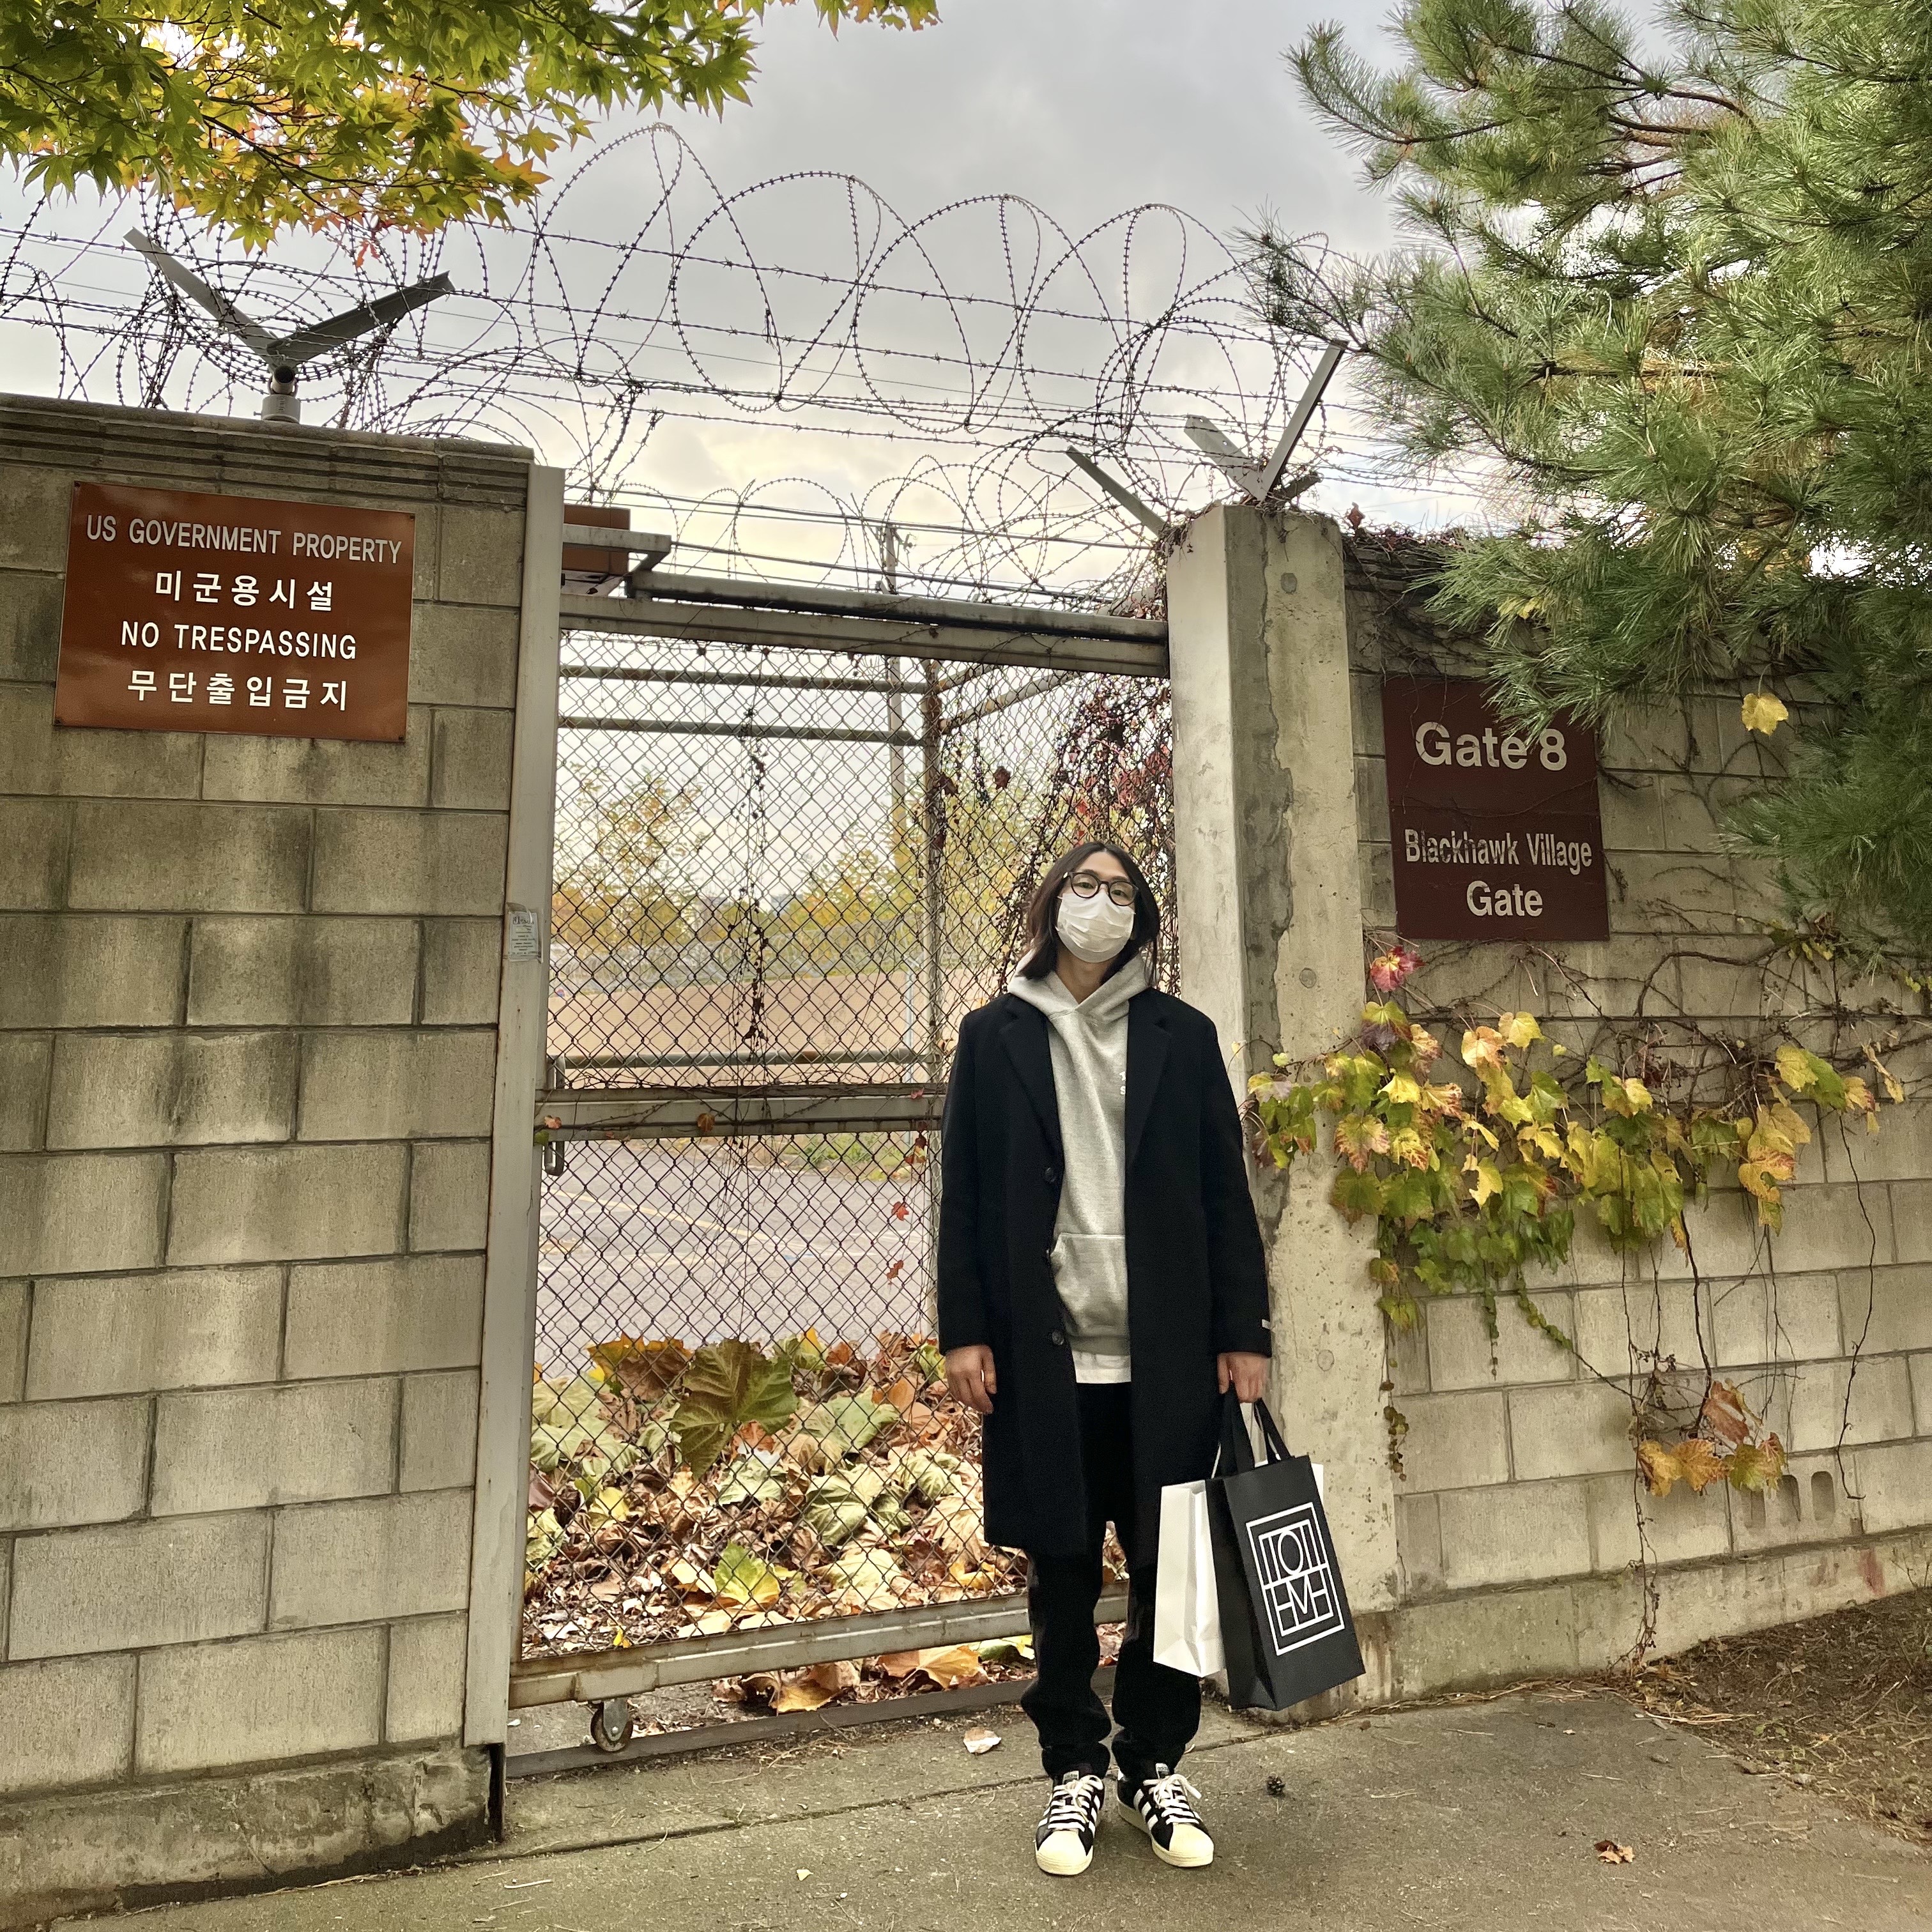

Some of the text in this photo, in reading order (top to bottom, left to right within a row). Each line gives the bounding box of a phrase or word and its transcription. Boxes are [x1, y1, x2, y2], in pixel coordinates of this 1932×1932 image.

[88, 515, 401, 564] US GOVERNMENT PROPERTY
[156, 571, 332, 611] 미군용시설
[121, 620, 356, 659] NO TRESPASSING
[128, 670, 346, 711] 무단출입금지
[1415, 721, 1567, 771] Gate 8
[1405, 829, 1592, 875] Blackhawk Village
[1466, 880, 1543, 917] Gate
